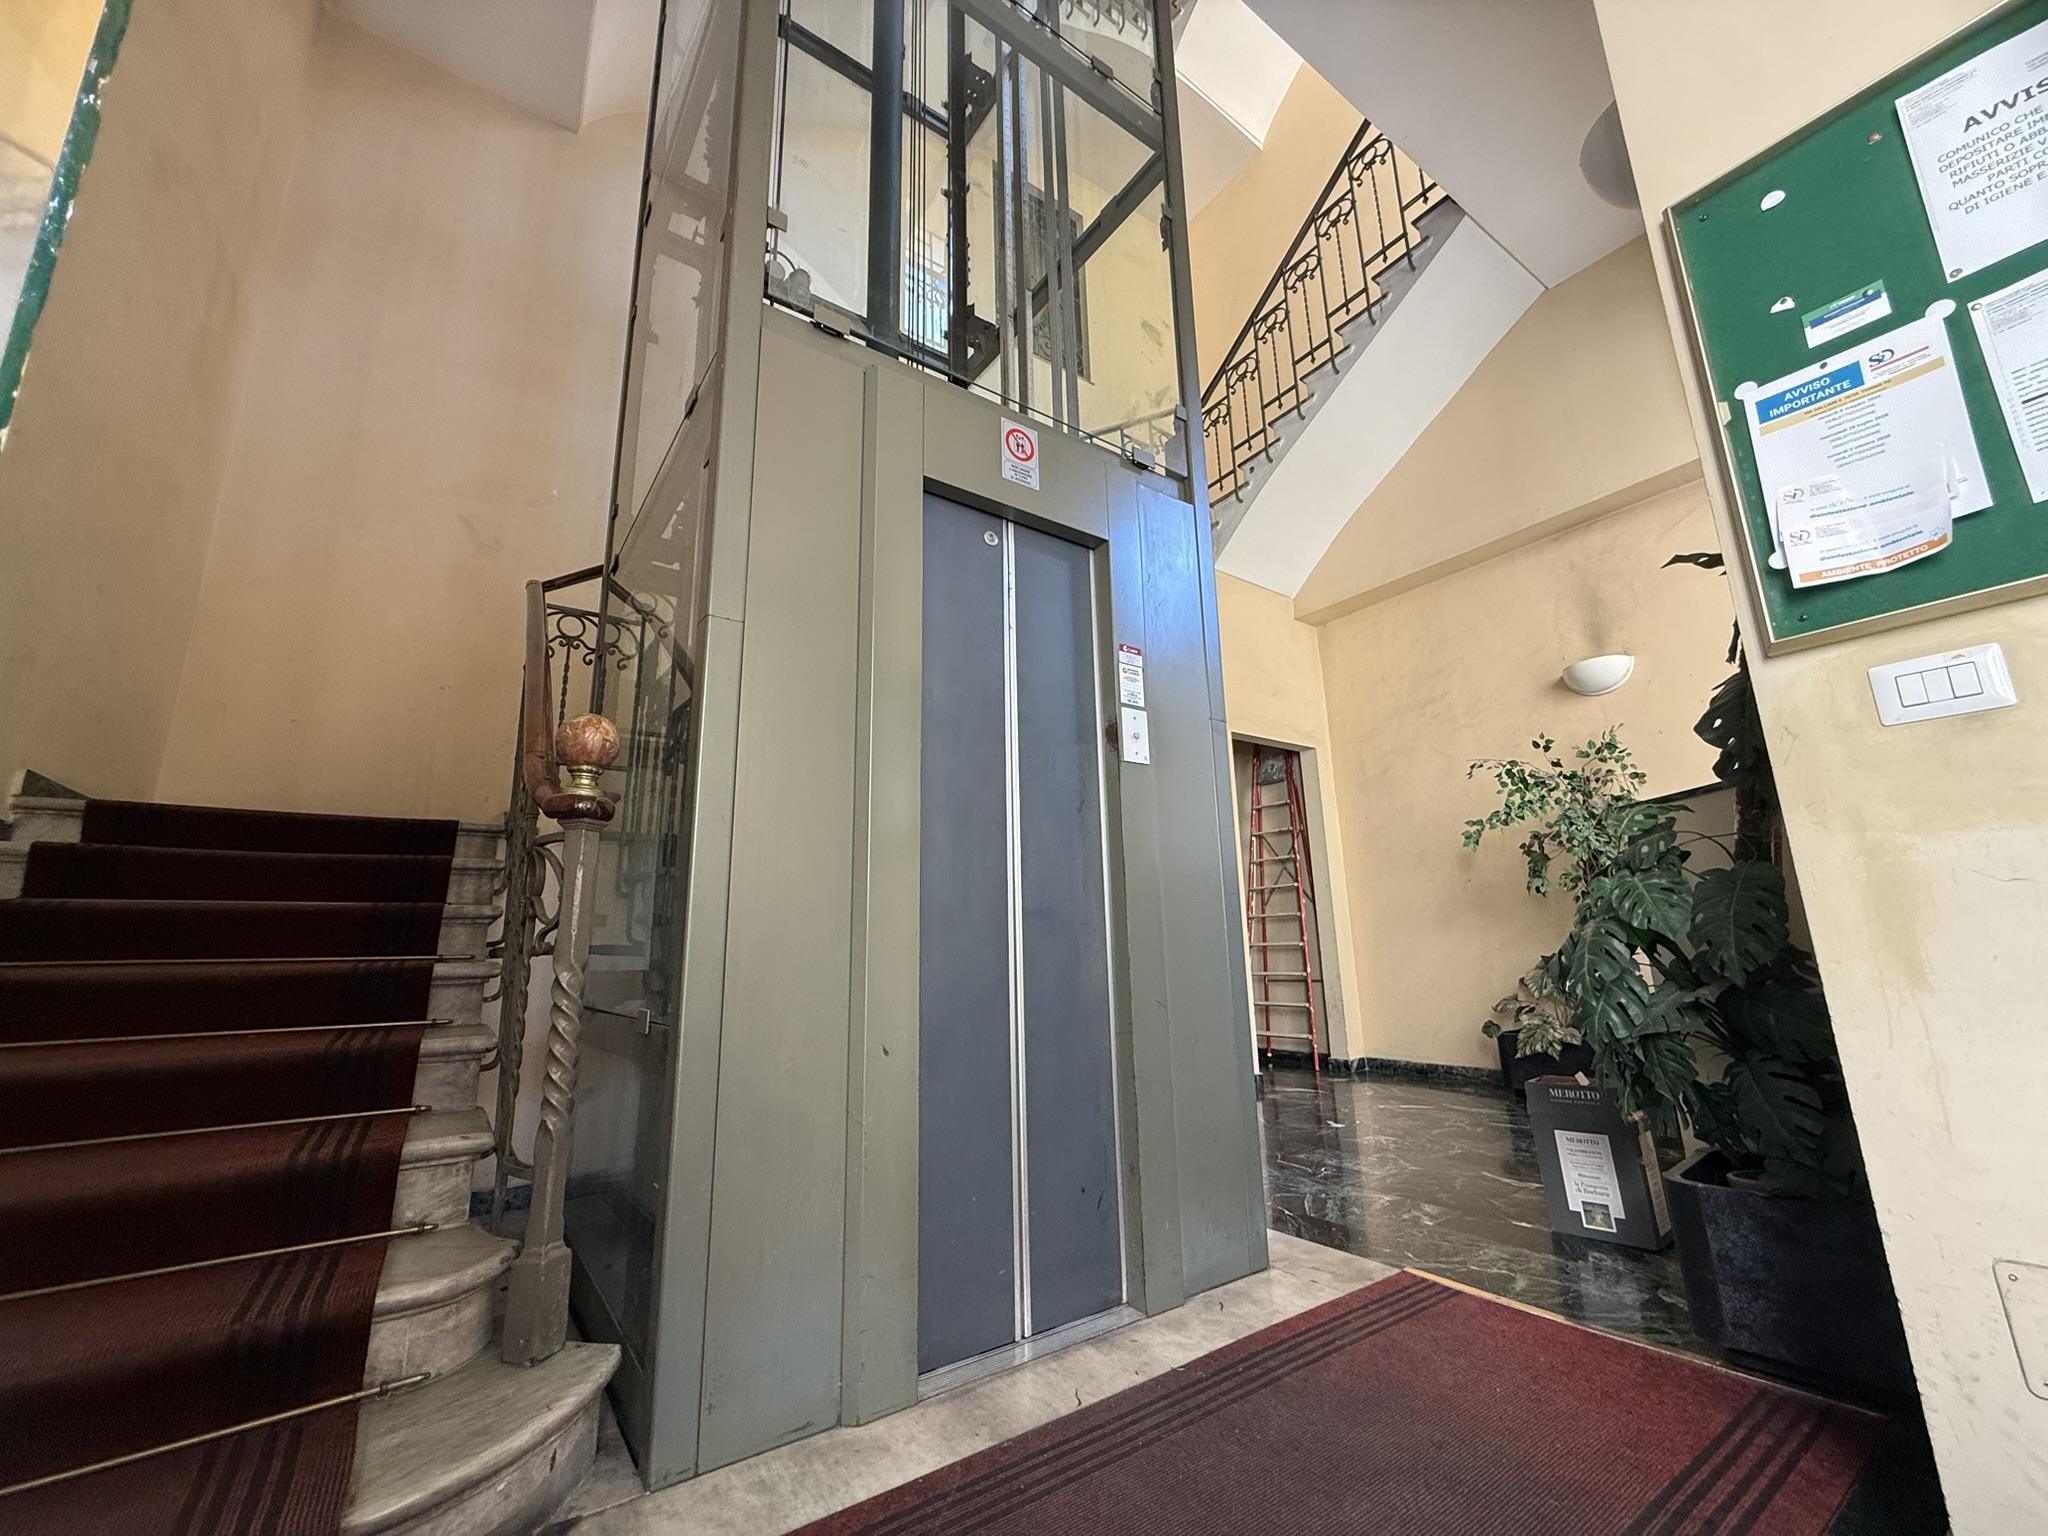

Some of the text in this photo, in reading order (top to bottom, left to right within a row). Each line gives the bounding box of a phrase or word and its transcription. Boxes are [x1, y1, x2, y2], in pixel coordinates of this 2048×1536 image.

[1937, 104, 2044, 164] COMUNICO CHE
[1938, 126, 2023, 174] DEPOSITARE
[1949, 149, 1999, 179] RIFIUTI
[2003, 142, 2015, 152] O
[1952, 143, 2034, 188] MASSERIZIE
[1987, 157, 2029, 182] PARTI
[1948, 179, 2005, 211] QUANTO
[1964, 203, 1981, 215] DI
[1984, 177, 2033, 205] IGIENE
[1769, 379, 1852, 418] IMPORTANTE
[1783, 377, 1831, 402] AVVISO
[1821, 562, 1873, 578] AMBIENTE
[1549, 1087, 1601, 1100] MEROTTO
